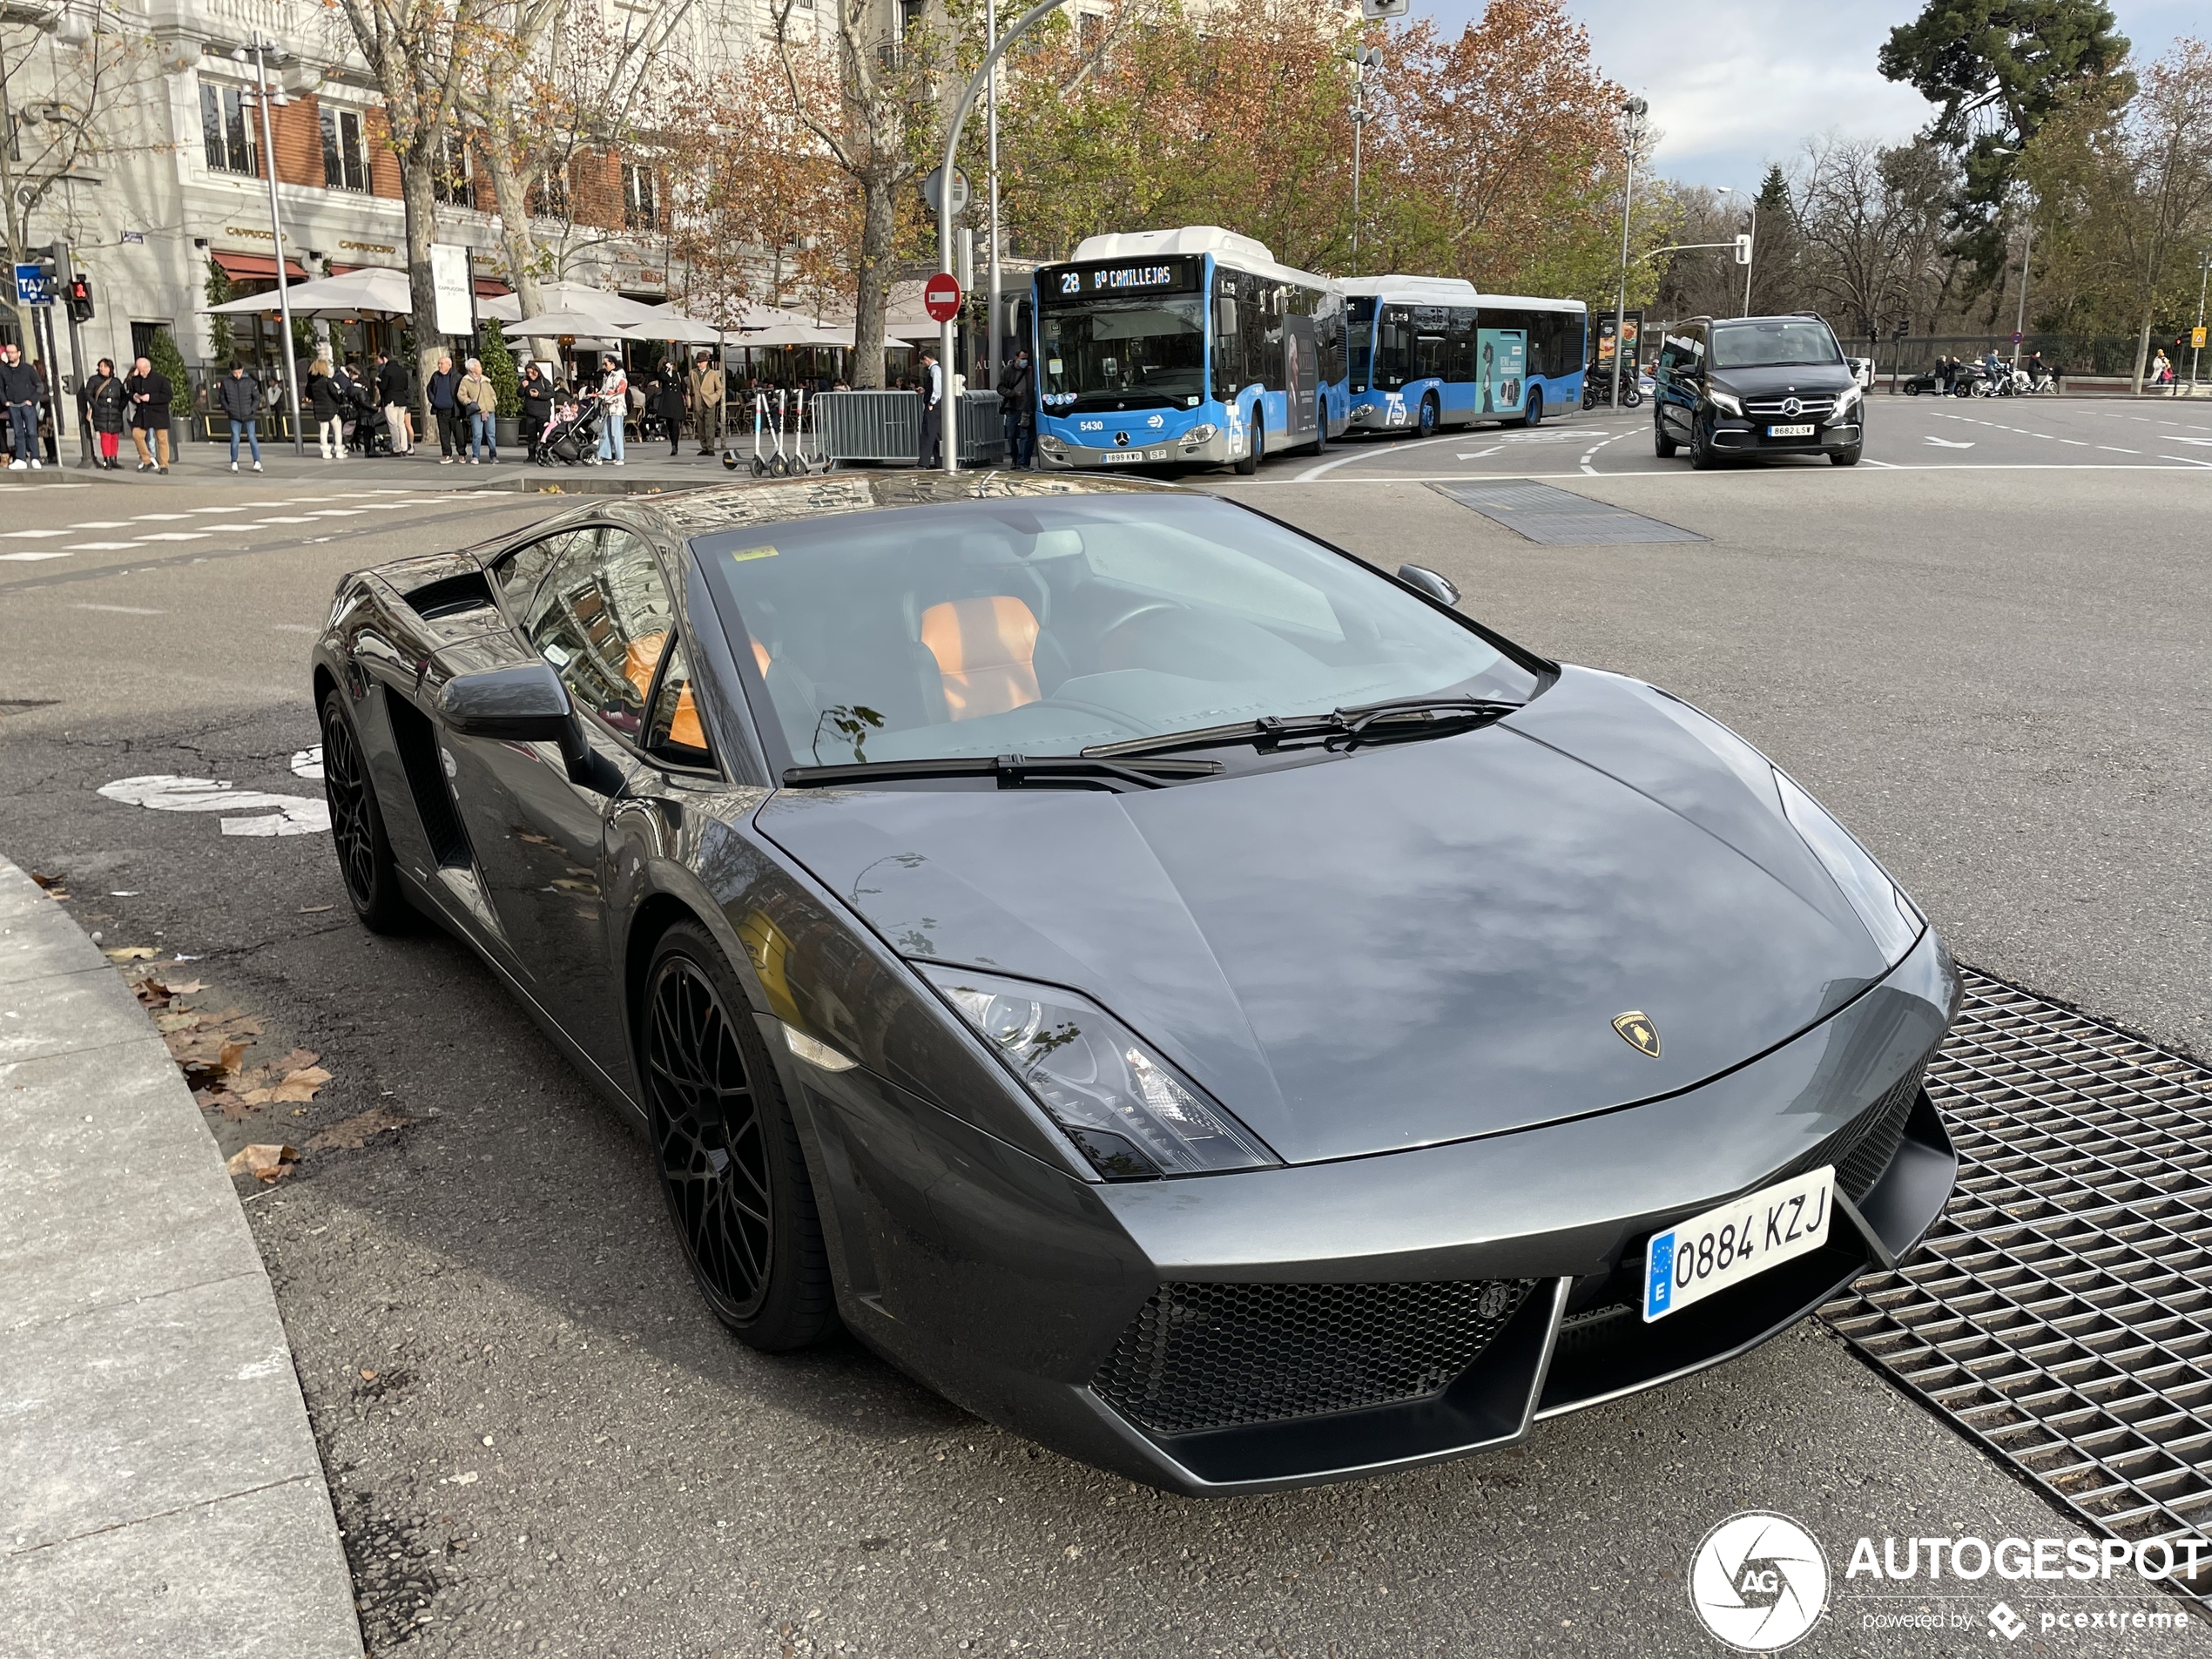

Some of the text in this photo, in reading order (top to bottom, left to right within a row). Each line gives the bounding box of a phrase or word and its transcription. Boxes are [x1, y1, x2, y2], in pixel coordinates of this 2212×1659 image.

[1061, 272, 1081, 293] 28
[1109, 266, 1170, 288] CANILLEJAS
[1080, 421, 1103, 431] 5430
[1676, 1185, 1826, 1289] 0884 KZJ
[1655, 1281, 1666, 1302] E
